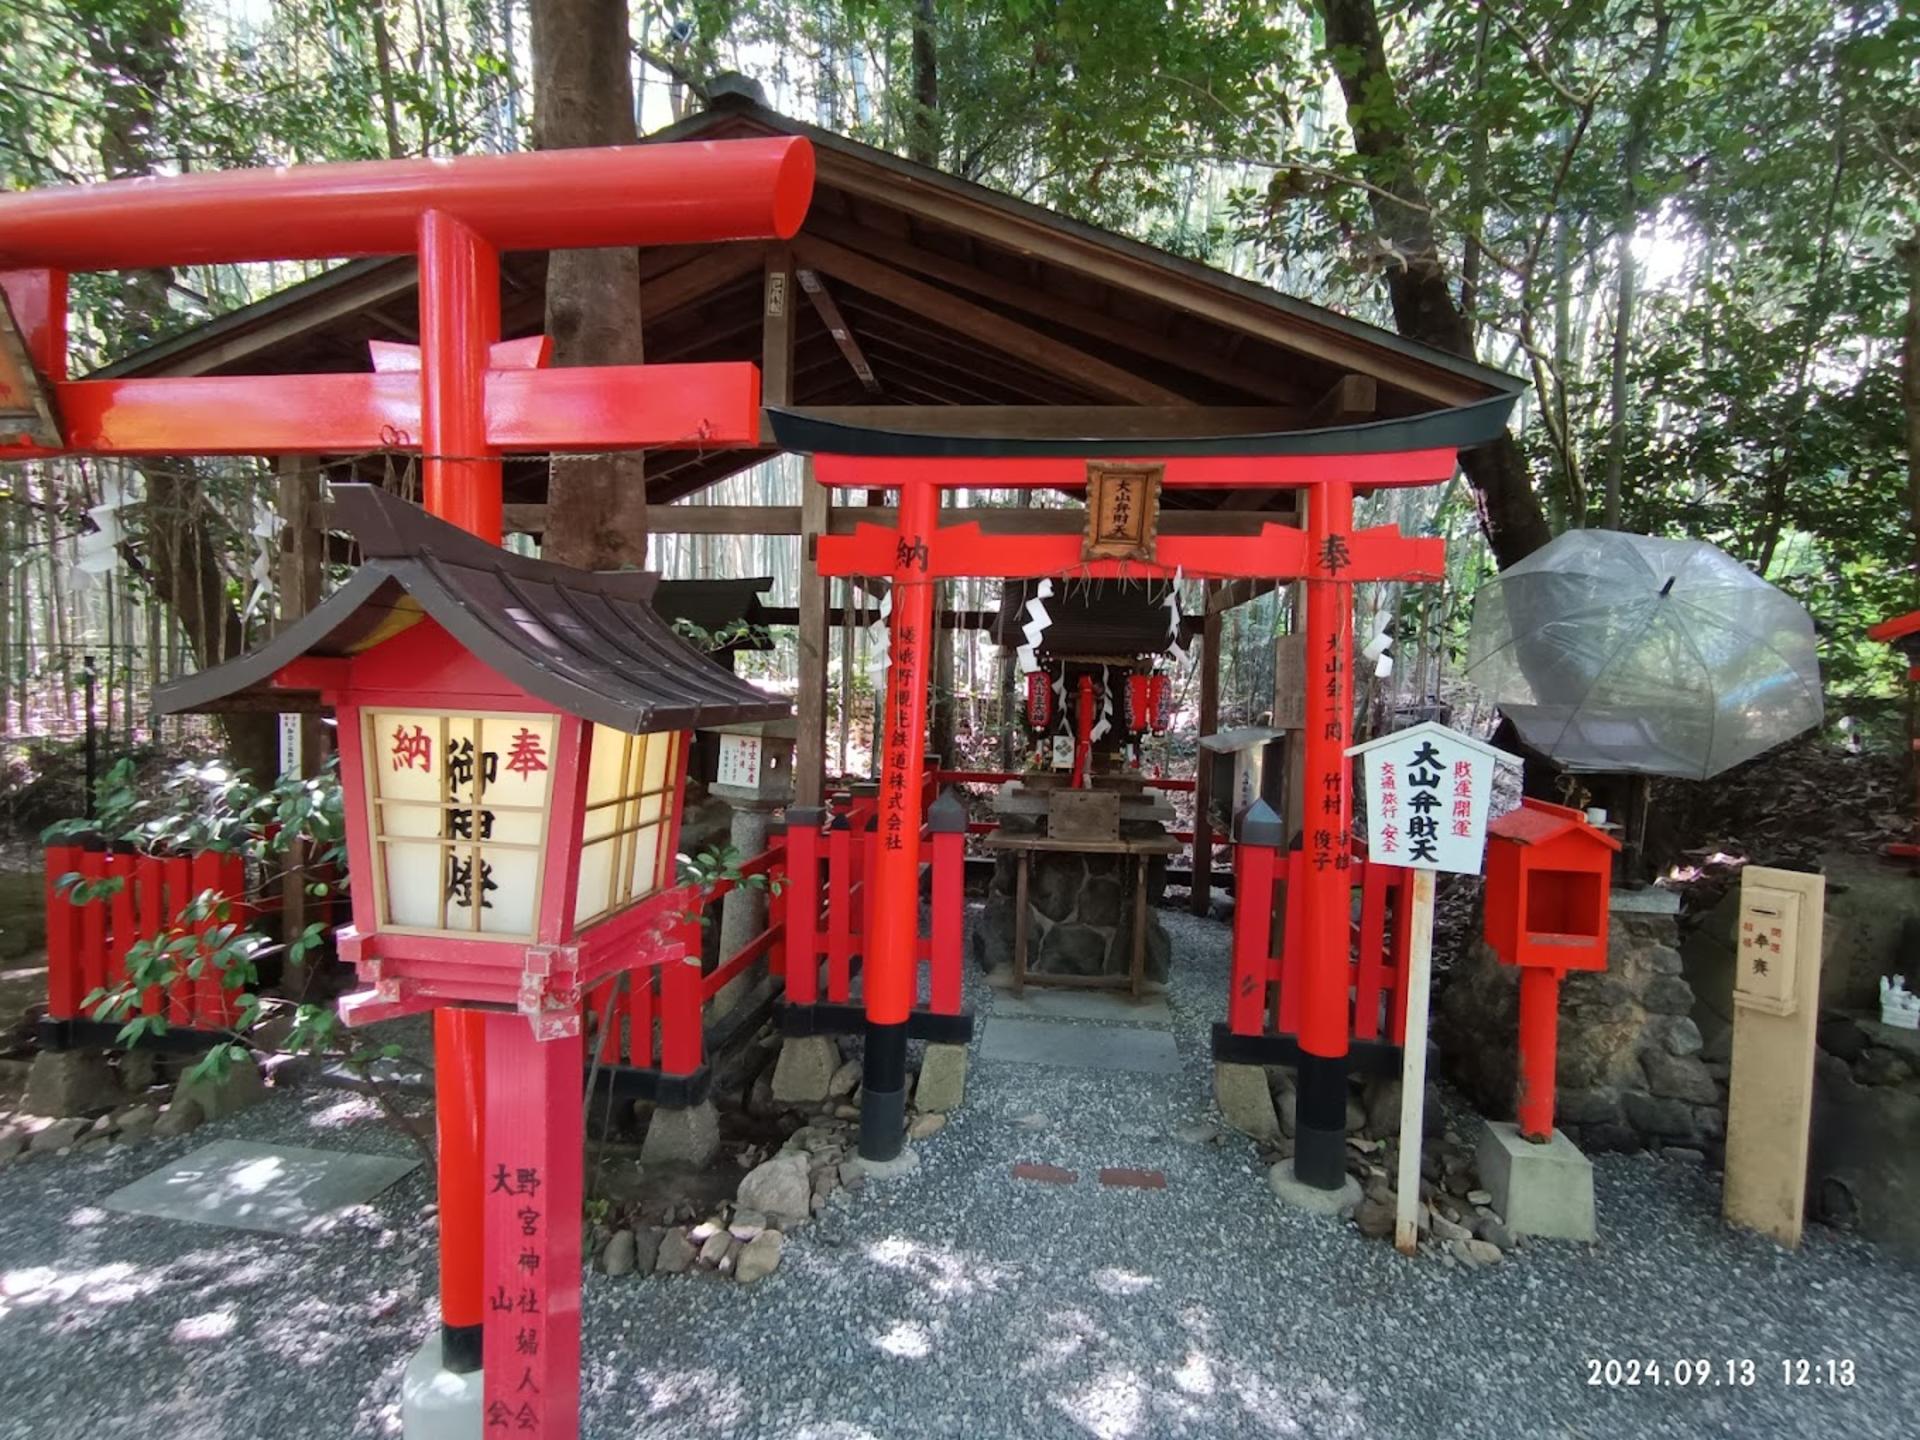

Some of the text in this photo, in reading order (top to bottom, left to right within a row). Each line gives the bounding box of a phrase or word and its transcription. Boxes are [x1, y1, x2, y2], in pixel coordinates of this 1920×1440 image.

[895, 535, 929, 573] 納
[1315, 533, 1352, 578] 奉
[391, 723, 433, 774] 納
[504, 728, 549, 783] 奉
[1322, 771, 1342, 815] 竹村
[1405, 740, 1447, 863] 大山弁財天
[1452, 760, 1473, 838] 財運開運
[514, 1167, 541, 1433] 野宮神社婦人会
